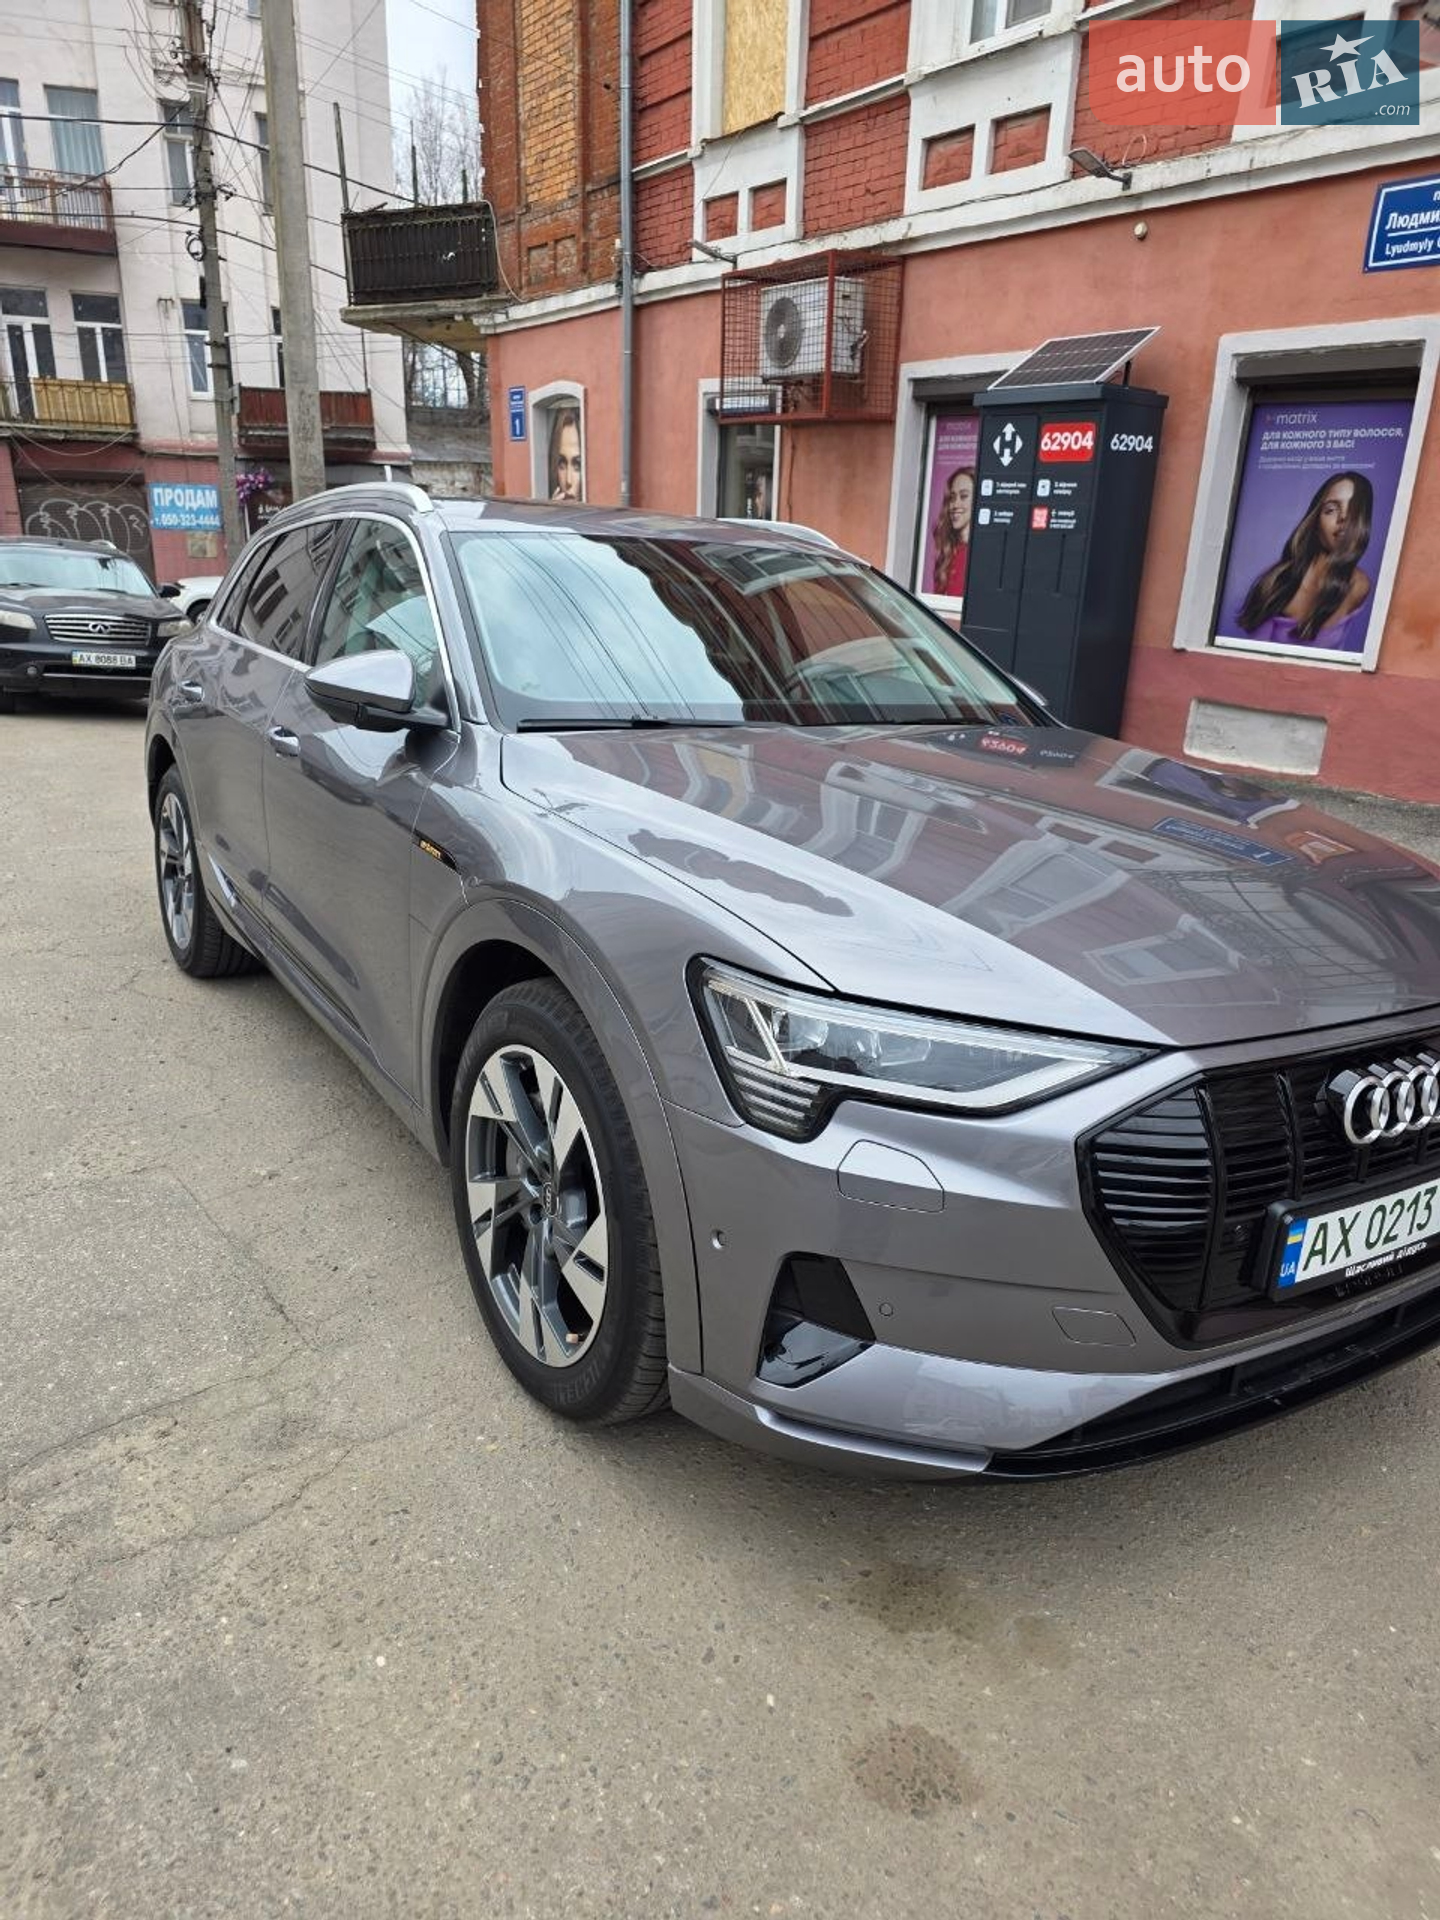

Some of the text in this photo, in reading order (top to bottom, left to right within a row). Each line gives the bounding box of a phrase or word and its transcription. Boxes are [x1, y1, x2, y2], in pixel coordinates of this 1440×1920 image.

[1385, 237, 1434, 257] Lyudmyly
[514, 418, 520, 436] 1
[1276, 411, 1318, 425] matrix
[1040, 431, 1094, 452] 62904
[1110, 433, 1153, 453] 62904
[153, 487, 217, 511] ПРОДАМ
[79, 654, 92, 663] AX
[1302, 1185, 1438, 1272] AX 0213
[1279, 1260, 1297, 1278] UA
